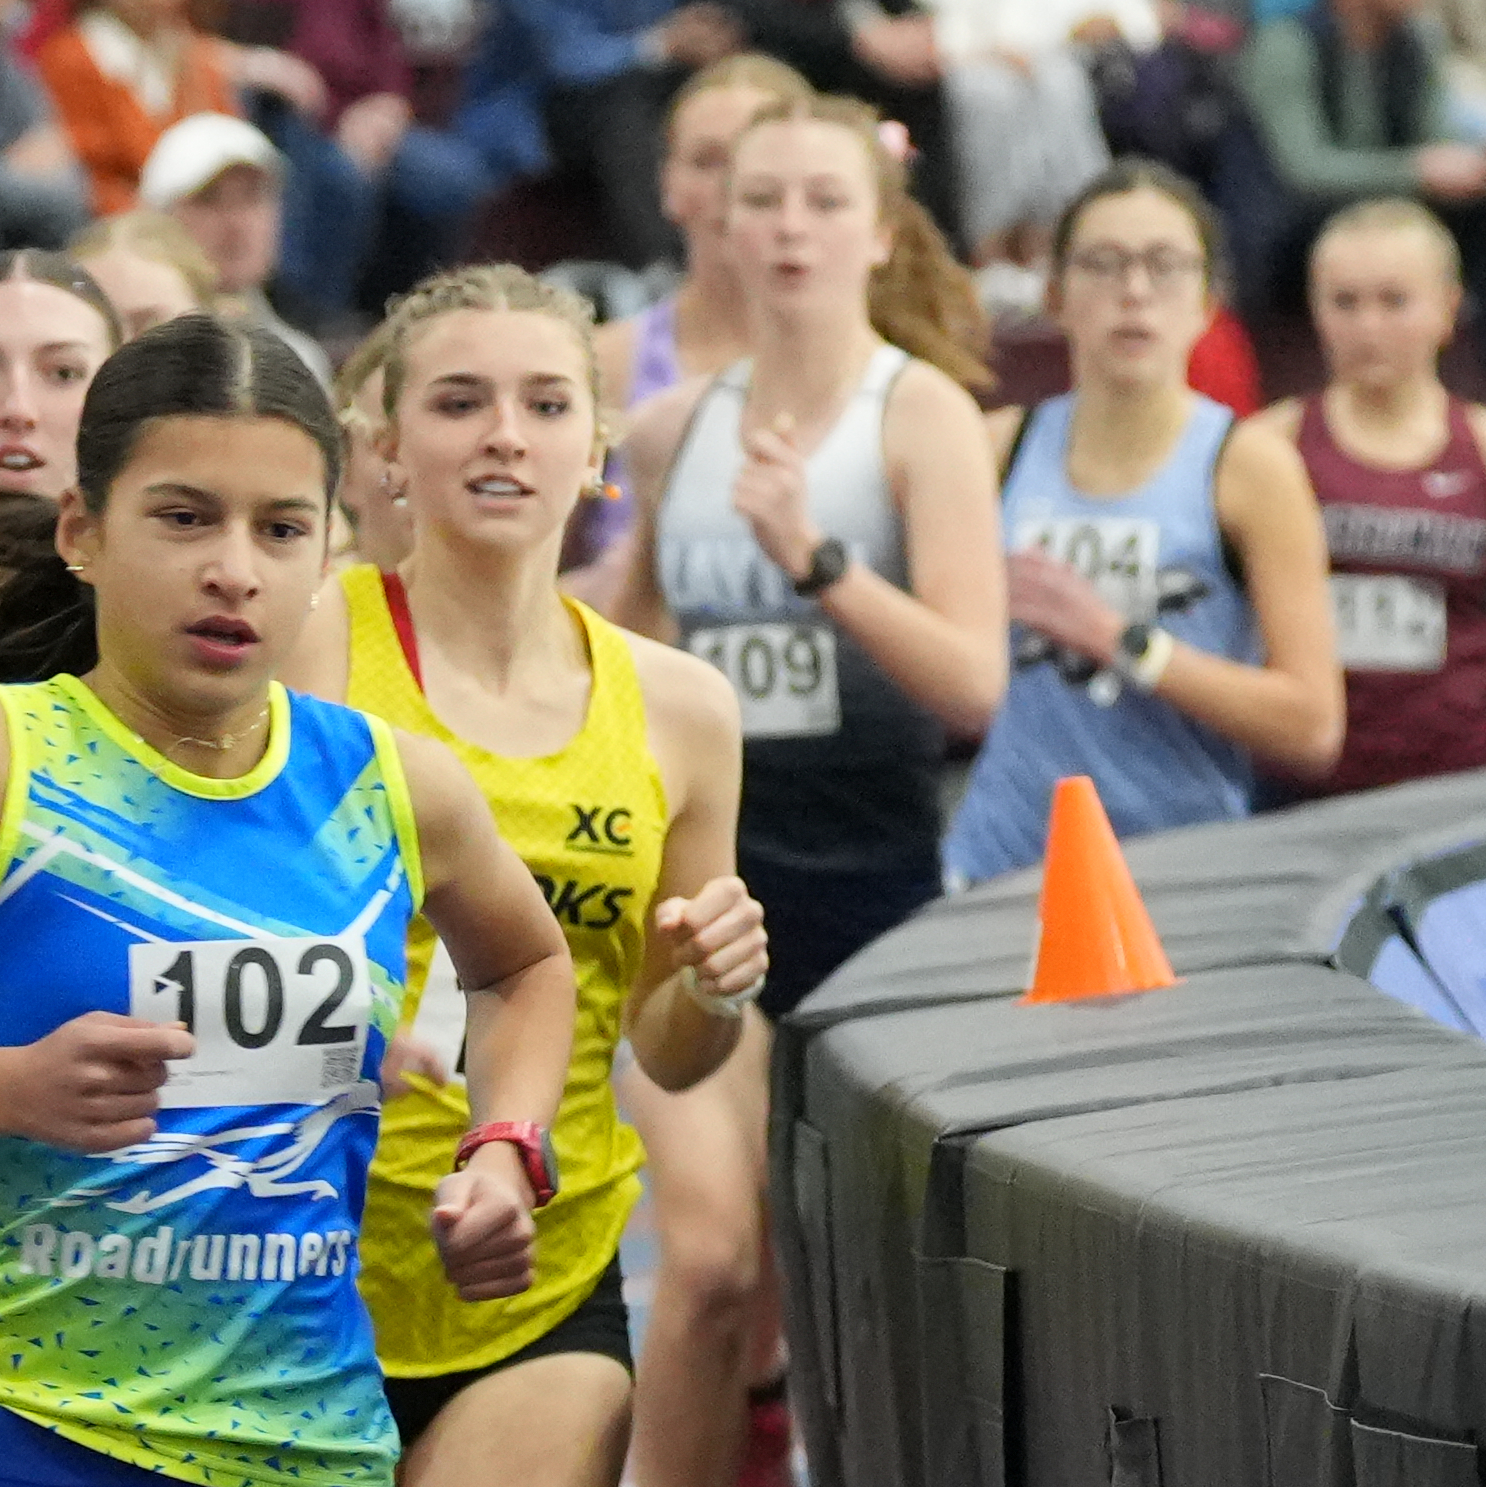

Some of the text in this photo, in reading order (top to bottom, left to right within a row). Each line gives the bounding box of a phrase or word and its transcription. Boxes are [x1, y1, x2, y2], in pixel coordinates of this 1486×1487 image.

[566, 804, 633, 845] XC
[154, 943, 357, 1049] 102
[20, 1223, 352, 1285] Roadrunners
